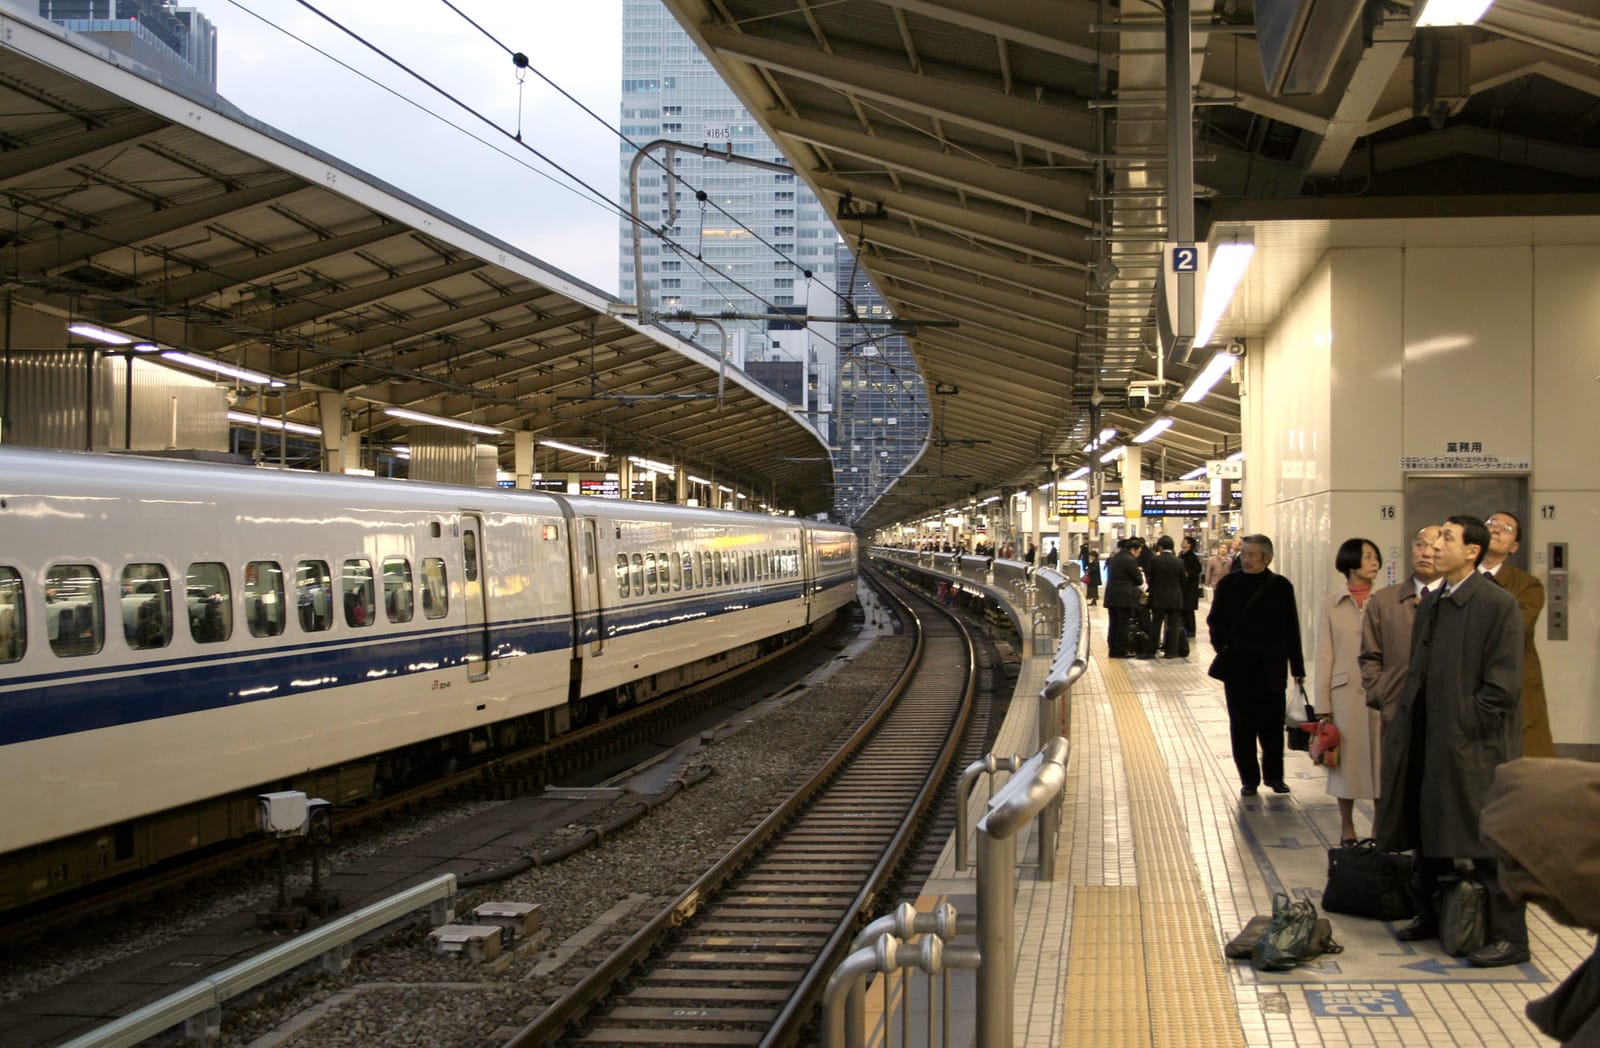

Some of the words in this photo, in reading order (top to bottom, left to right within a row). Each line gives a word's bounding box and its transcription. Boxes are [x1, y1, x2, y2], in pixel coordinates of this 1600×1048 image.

[1178, 250, 1192, 269] 2
[1446, 441, 1482, 453] 業務用
[1381, 506, 1394, 518] 16
[1541, 506, 1554, 519] 17
